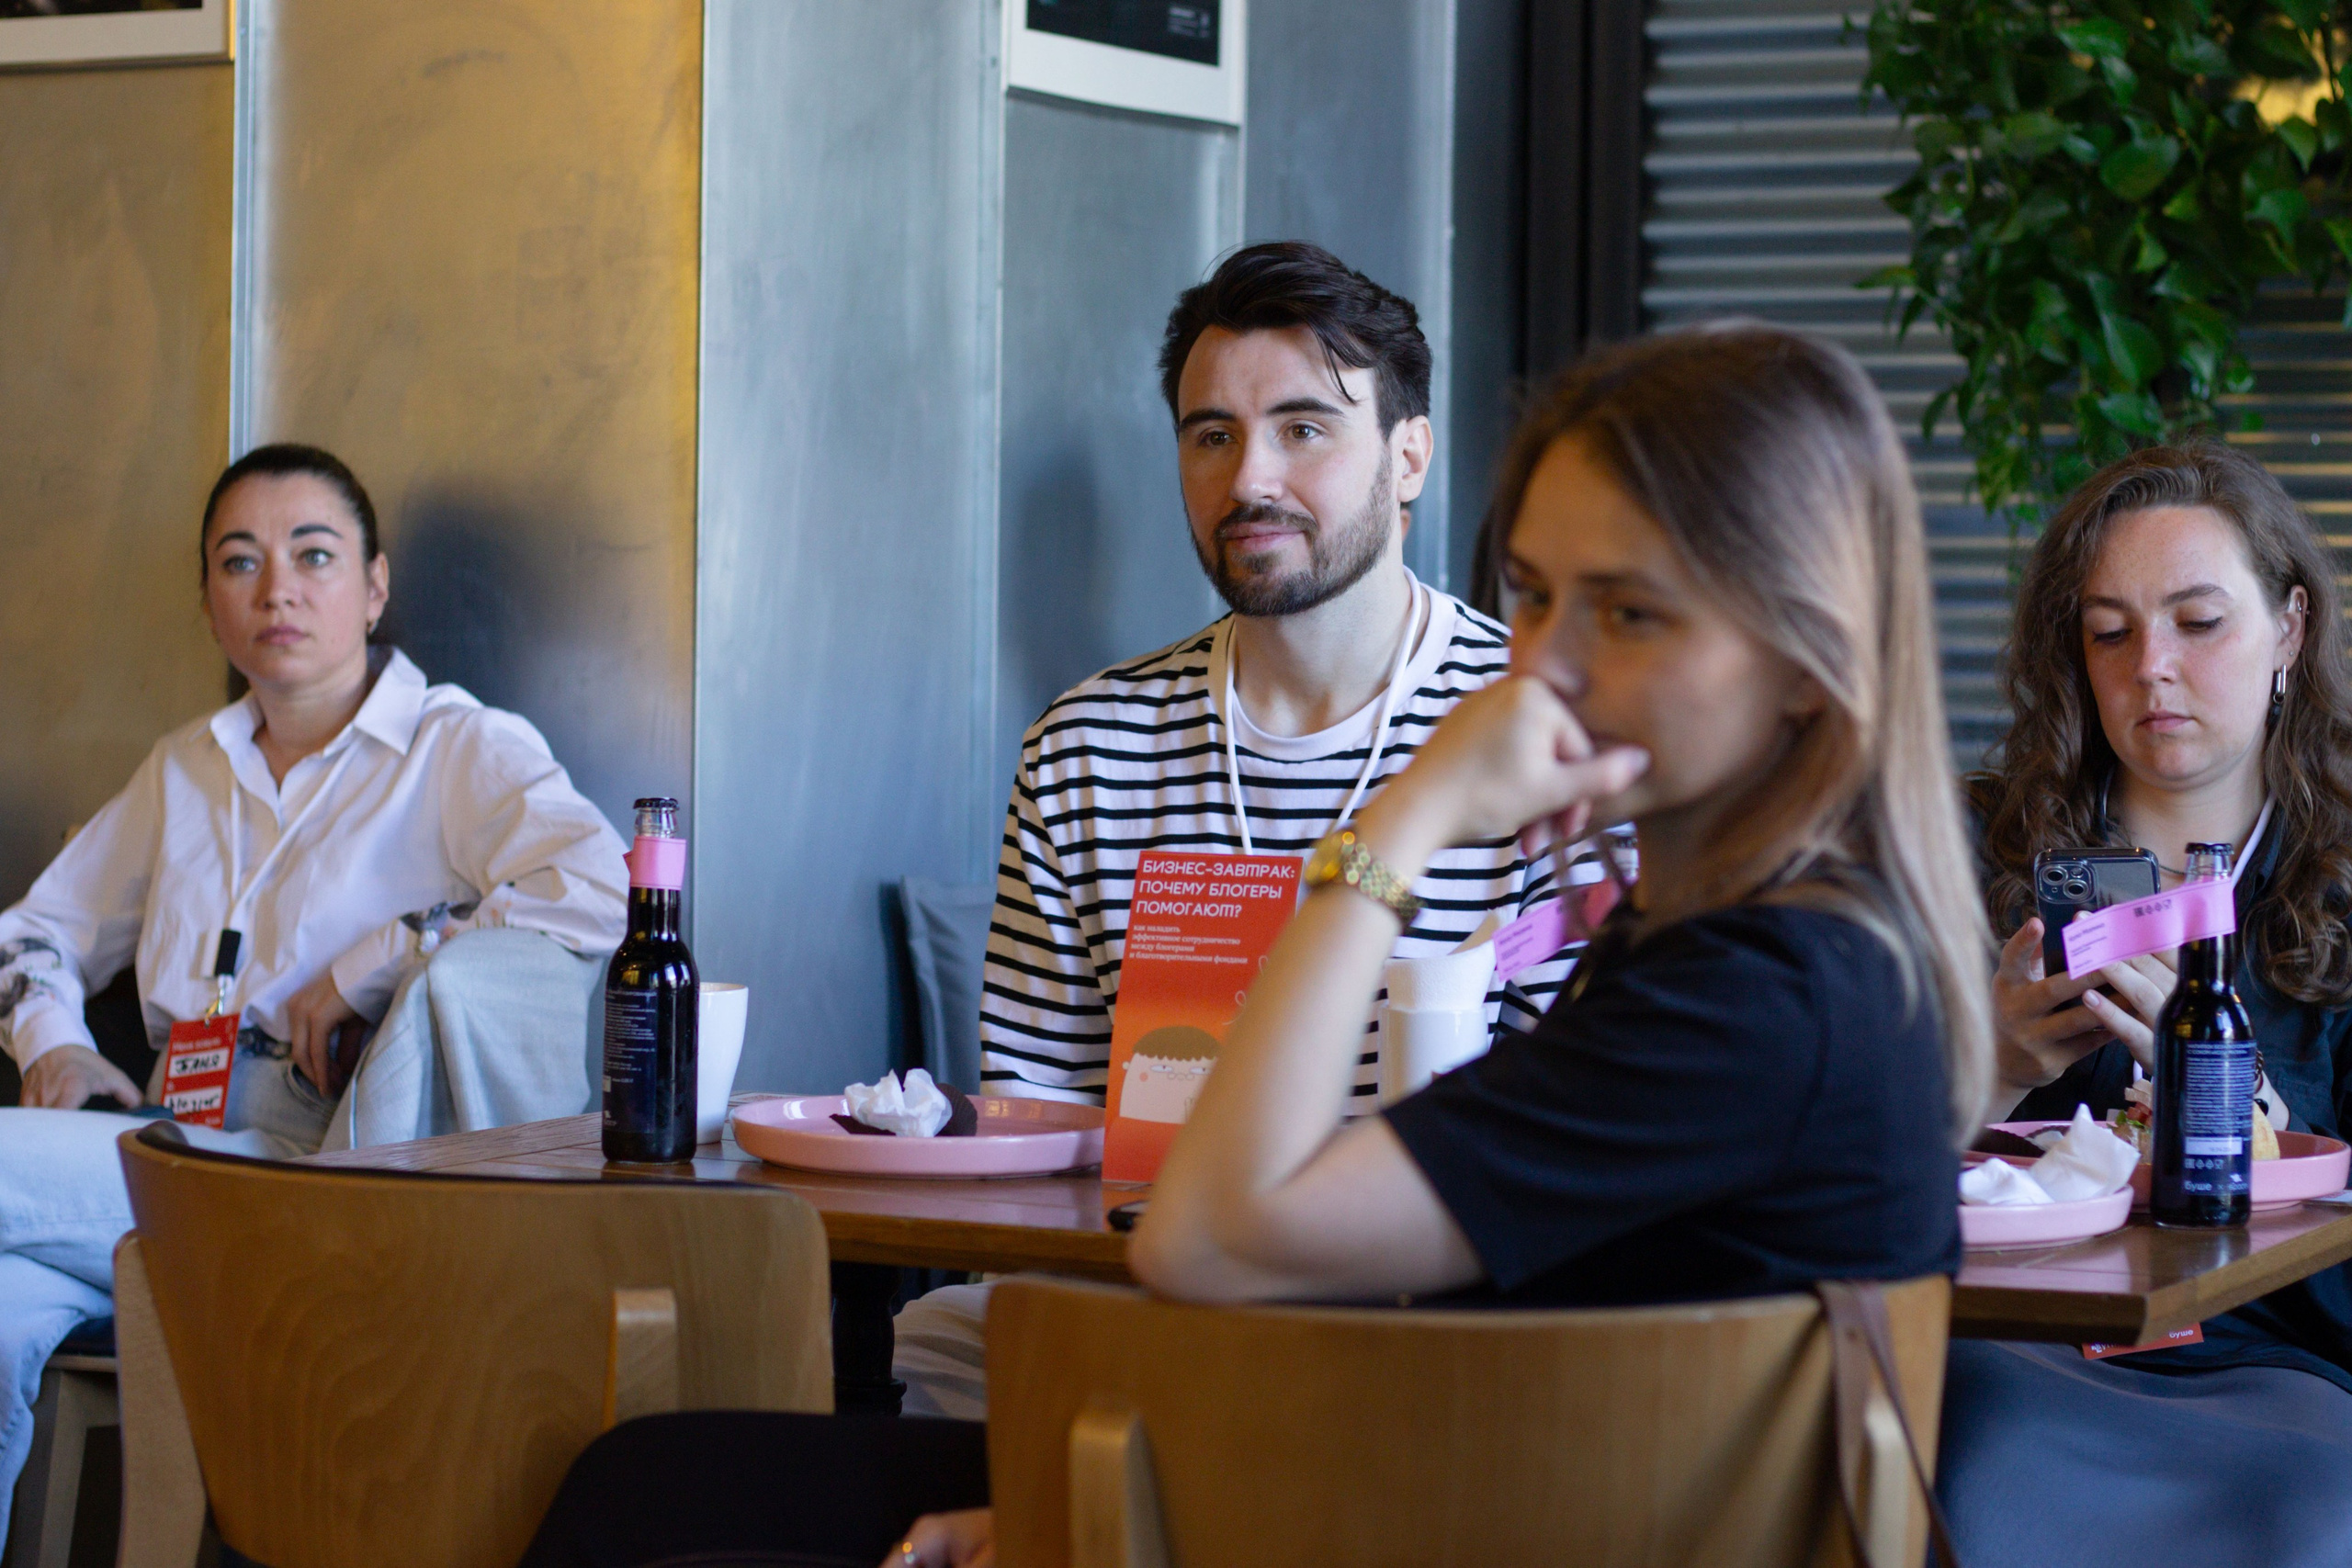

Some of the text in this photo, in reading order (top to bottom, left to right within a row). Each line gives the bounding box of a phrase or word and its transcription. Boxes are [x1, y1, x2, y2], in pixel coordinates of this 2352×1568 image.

[1142, 860, 1295, 878] БИЗНЕС-ЗАВТРАК:
[1138, 880, 1283, 899] ПОЧЕМУ БЛОГЕРЫ
[1136, 900, 1242, 918] ПОМОГАЮТ?
[1132, 933, 1241, 945] эффективное сотрудничество
[2184, 1179, 2212, 1192] буше
[2168, 1329, 2194, 1339] буше
